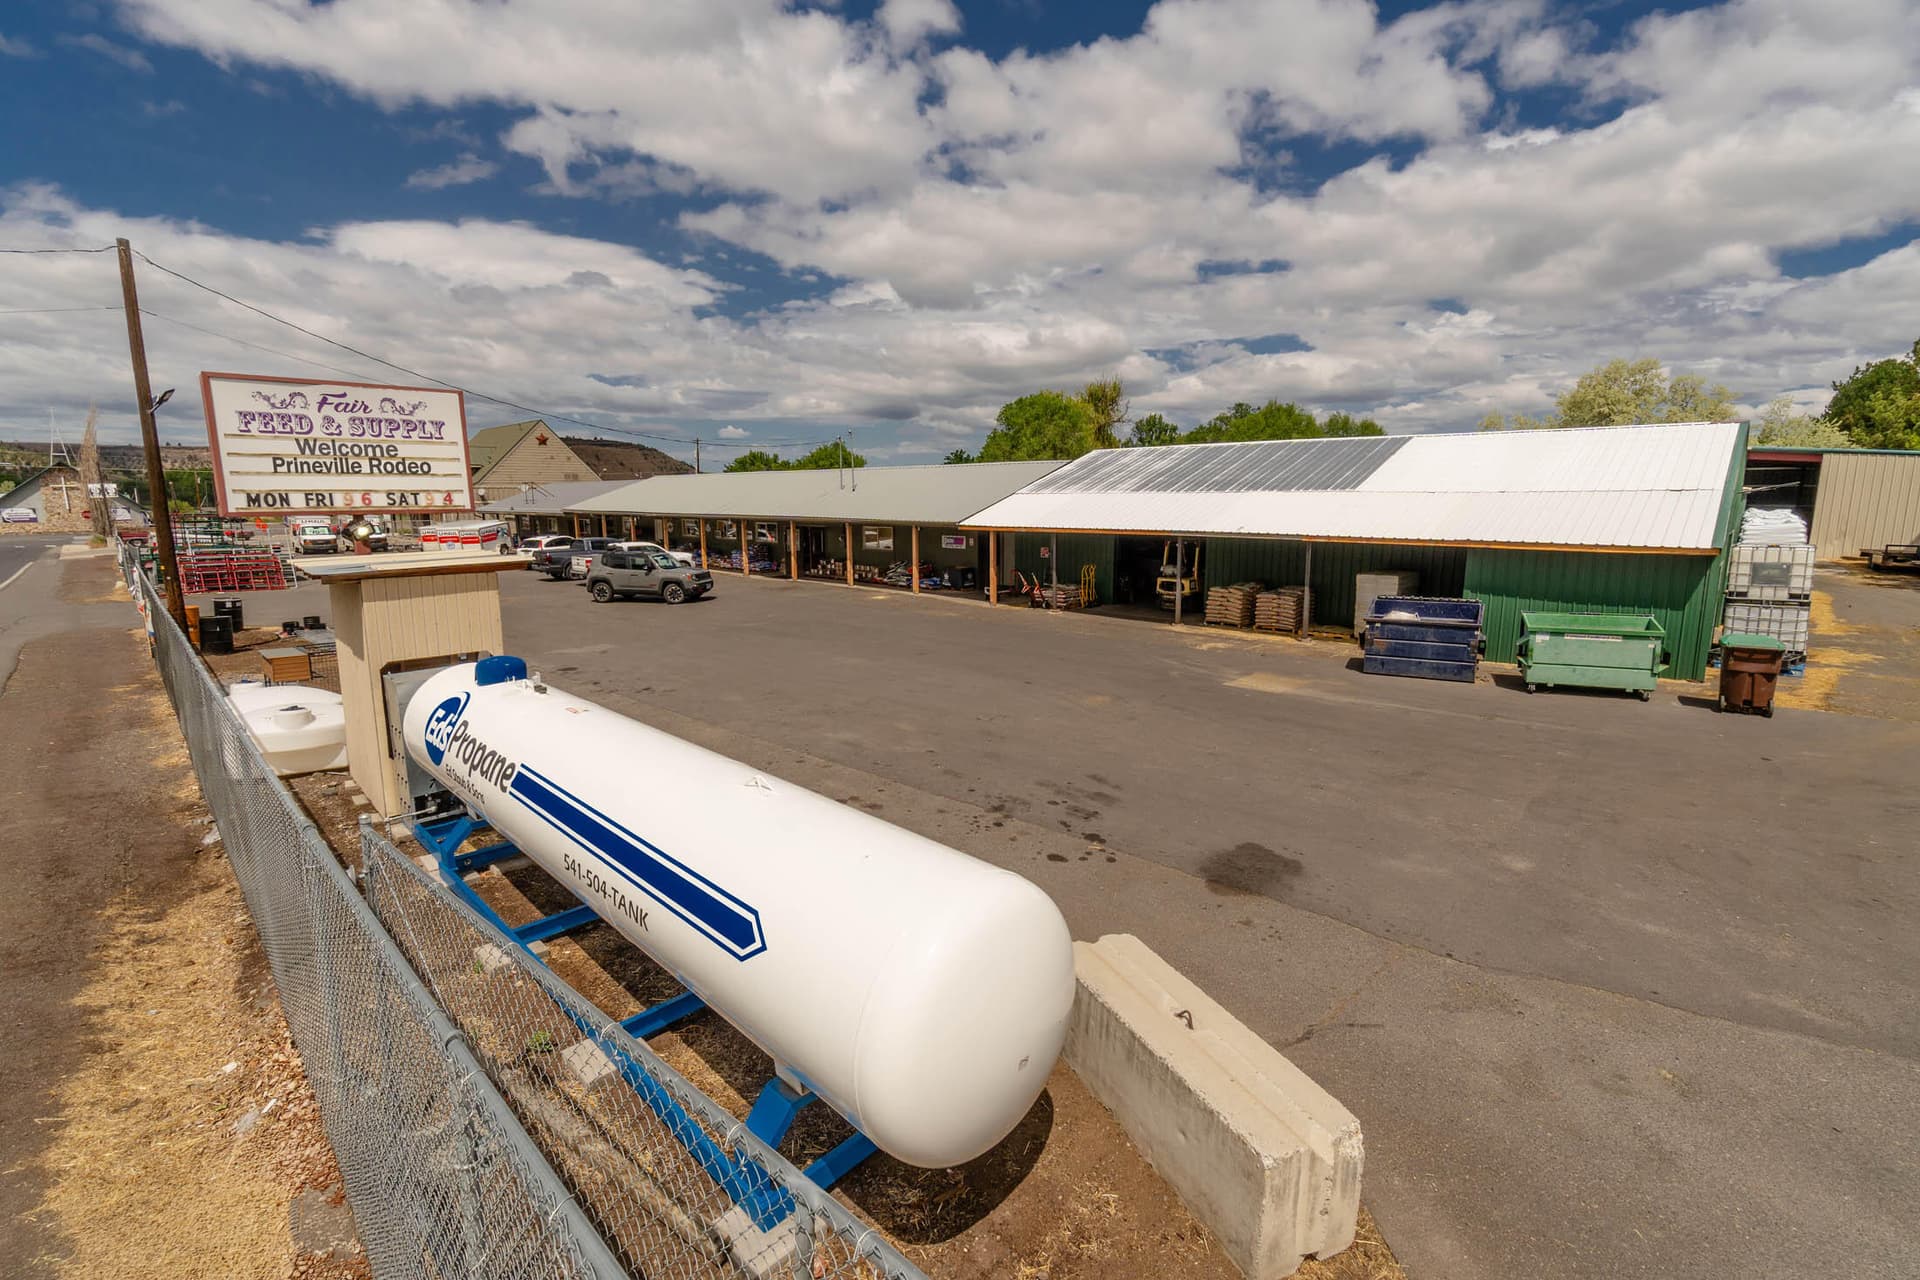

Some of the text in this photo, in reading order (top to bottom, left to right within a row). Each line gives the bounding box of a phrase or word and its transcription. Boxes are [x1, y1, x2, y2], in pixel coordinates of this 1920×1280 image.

[316, 391, 373, 414] Fair
[235, 410, 446, 440] FEED & SUPPLY
[294, 438, 399, 457] Welcome
[272, 456, 431, 475] Prineville Rodeo
[246, 492, 290, 507] MON
[305, 492, 334, 506] FRI
[361, 492, 372, 506] 6
[386, 492, 420, 505] SAT
[443, 493, 454, 505] 4
[425, 707, 516, 793] Ed's Propane
[563, 853, 649, 932] 541-504-TANK
